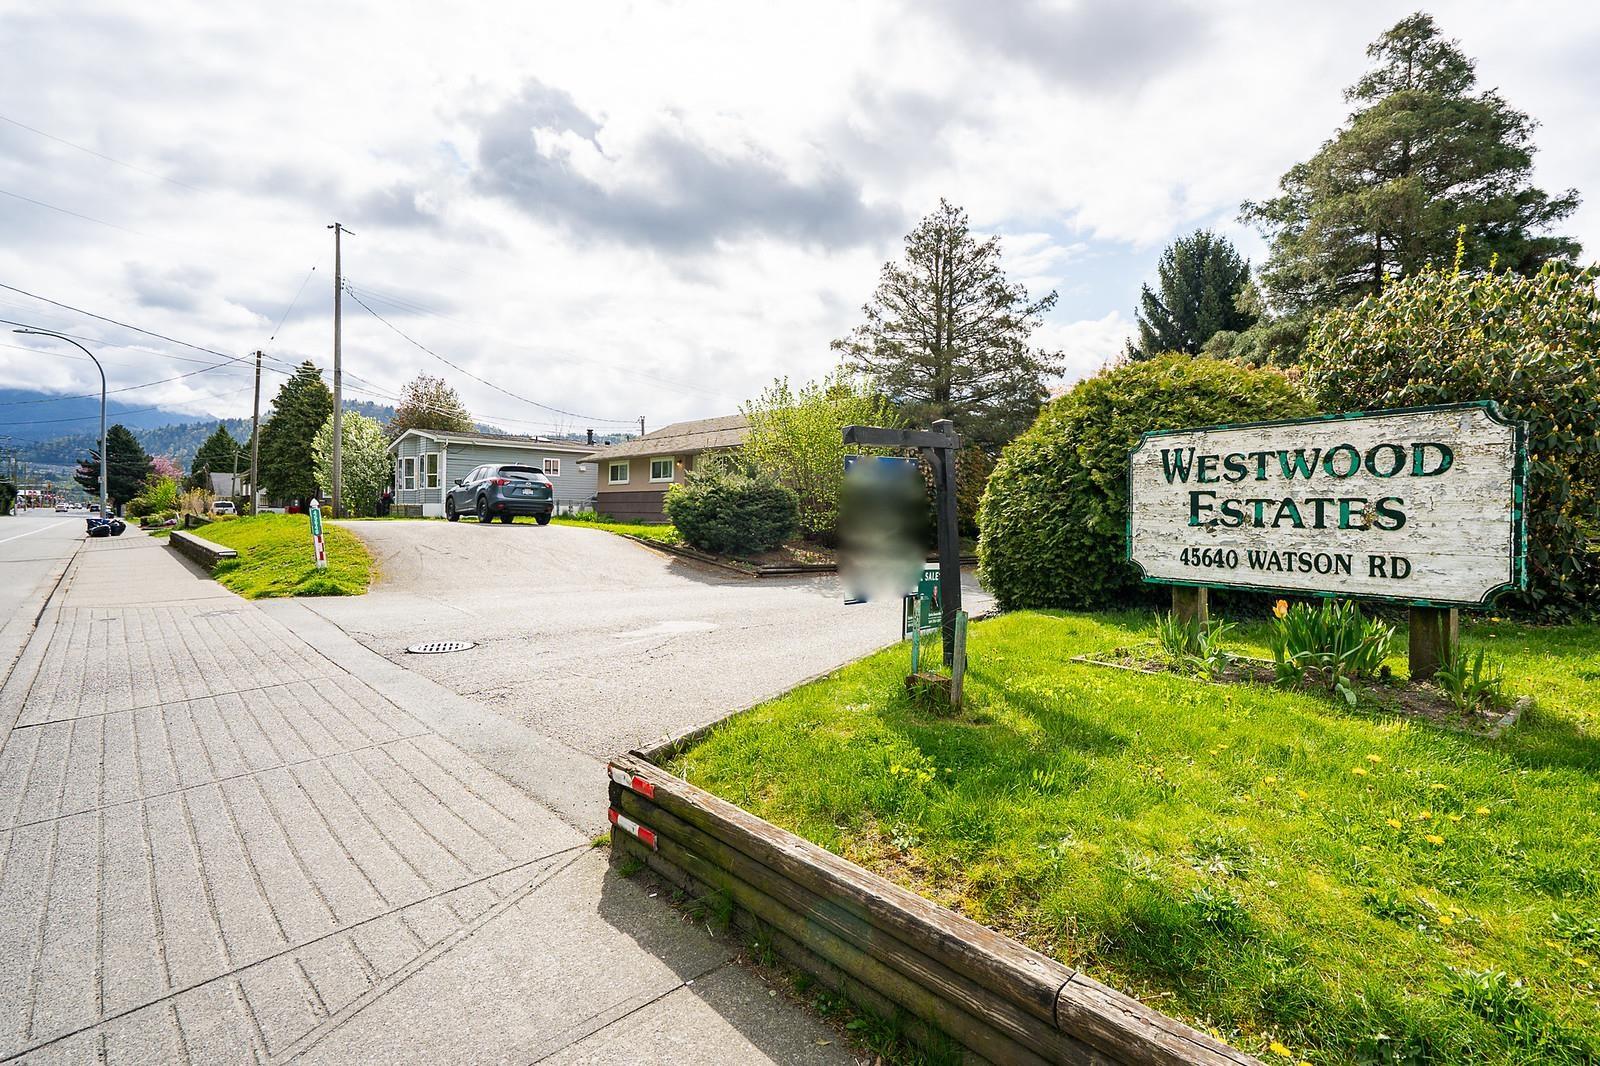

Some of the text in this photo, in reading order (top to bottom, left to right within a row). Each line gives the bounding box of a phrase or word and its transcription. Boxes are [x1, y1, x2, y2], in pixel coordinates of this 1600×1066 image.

[1160, 442, 1454, 484] WESTWOOD
[1187, 490, 1407, 531] ESTATES
[925, 571, 941, 582] SALE
[1179, 547, 1412, 580] 45640 WATSON RD
